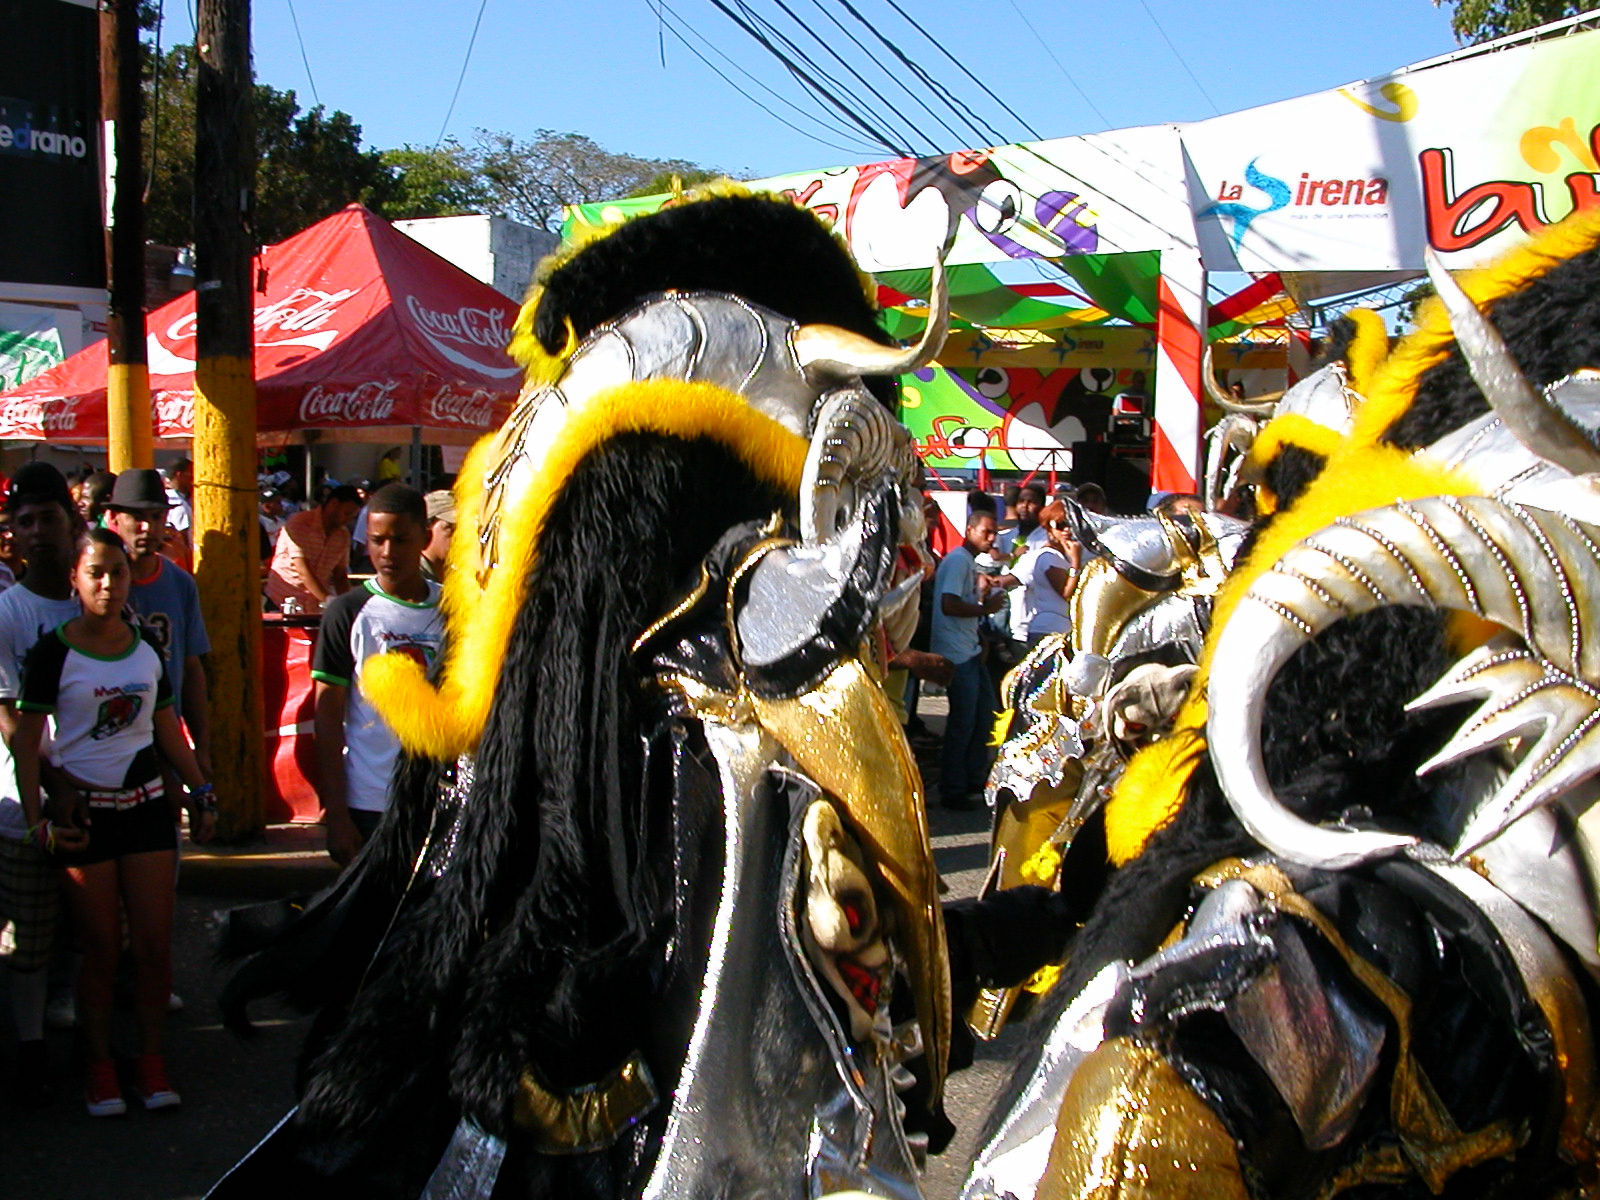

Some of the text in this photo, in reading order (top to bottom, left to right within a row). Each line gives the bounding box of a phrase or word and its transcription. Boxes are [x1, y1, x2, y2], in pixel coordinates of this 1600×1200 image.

[1218, 153, 1389, 222] La Sirena
[300, 379, 401, 423] Coca-Cola
